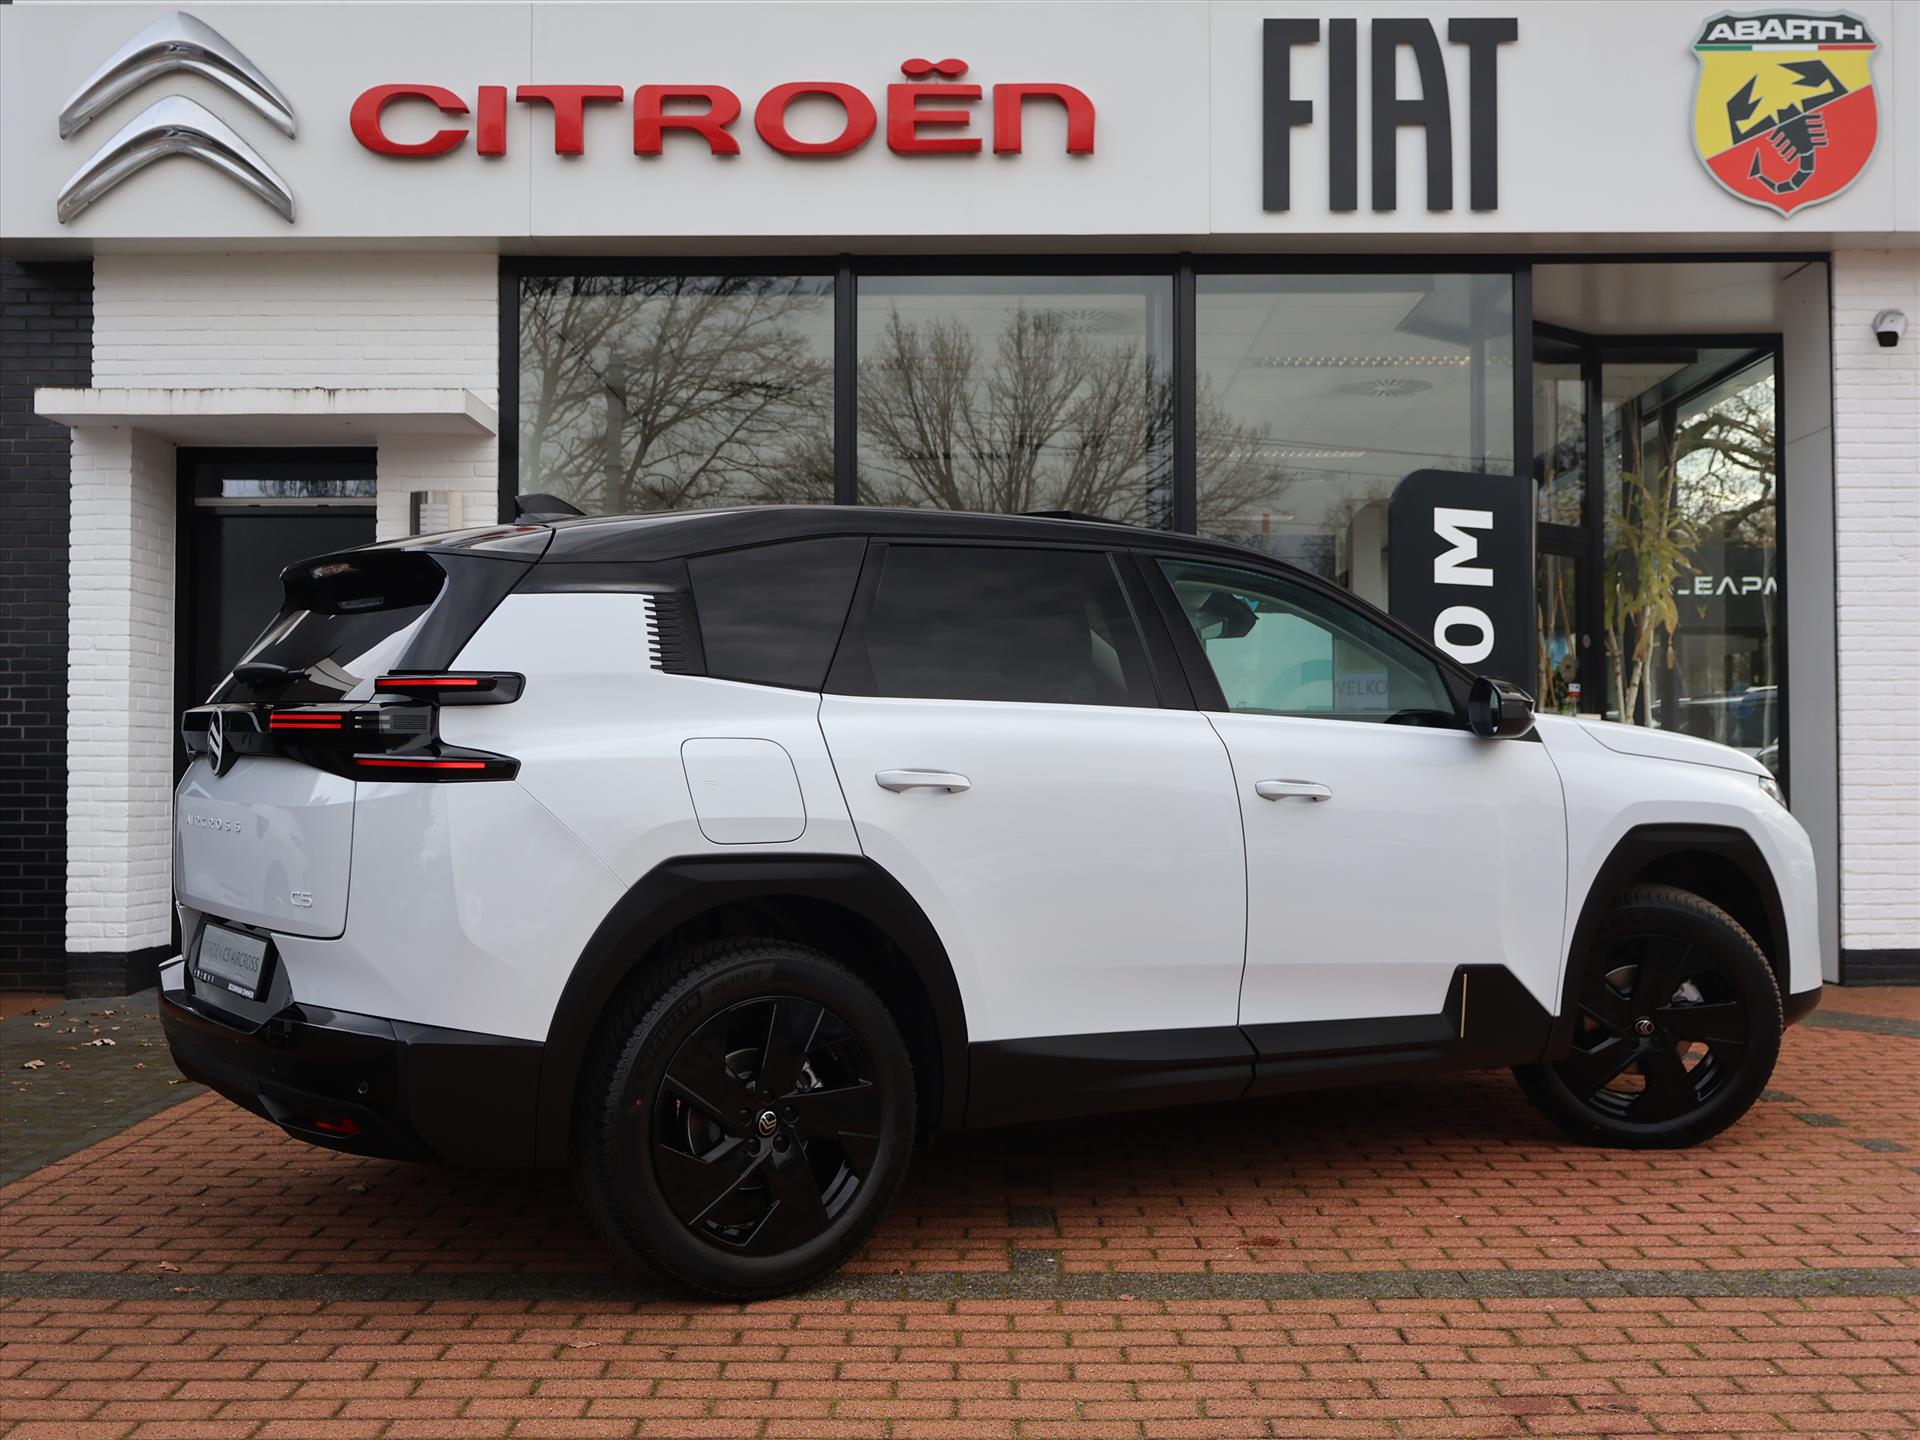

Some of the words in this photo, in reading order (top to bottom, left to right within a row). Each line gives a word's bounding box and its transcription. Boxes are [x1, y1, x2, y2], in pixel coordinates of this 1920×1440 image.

[1707, 18, 1863, 41] ABARTH
[1263, 18, 1518, 210] FIAT
[291, 892, 313, 908] C5
